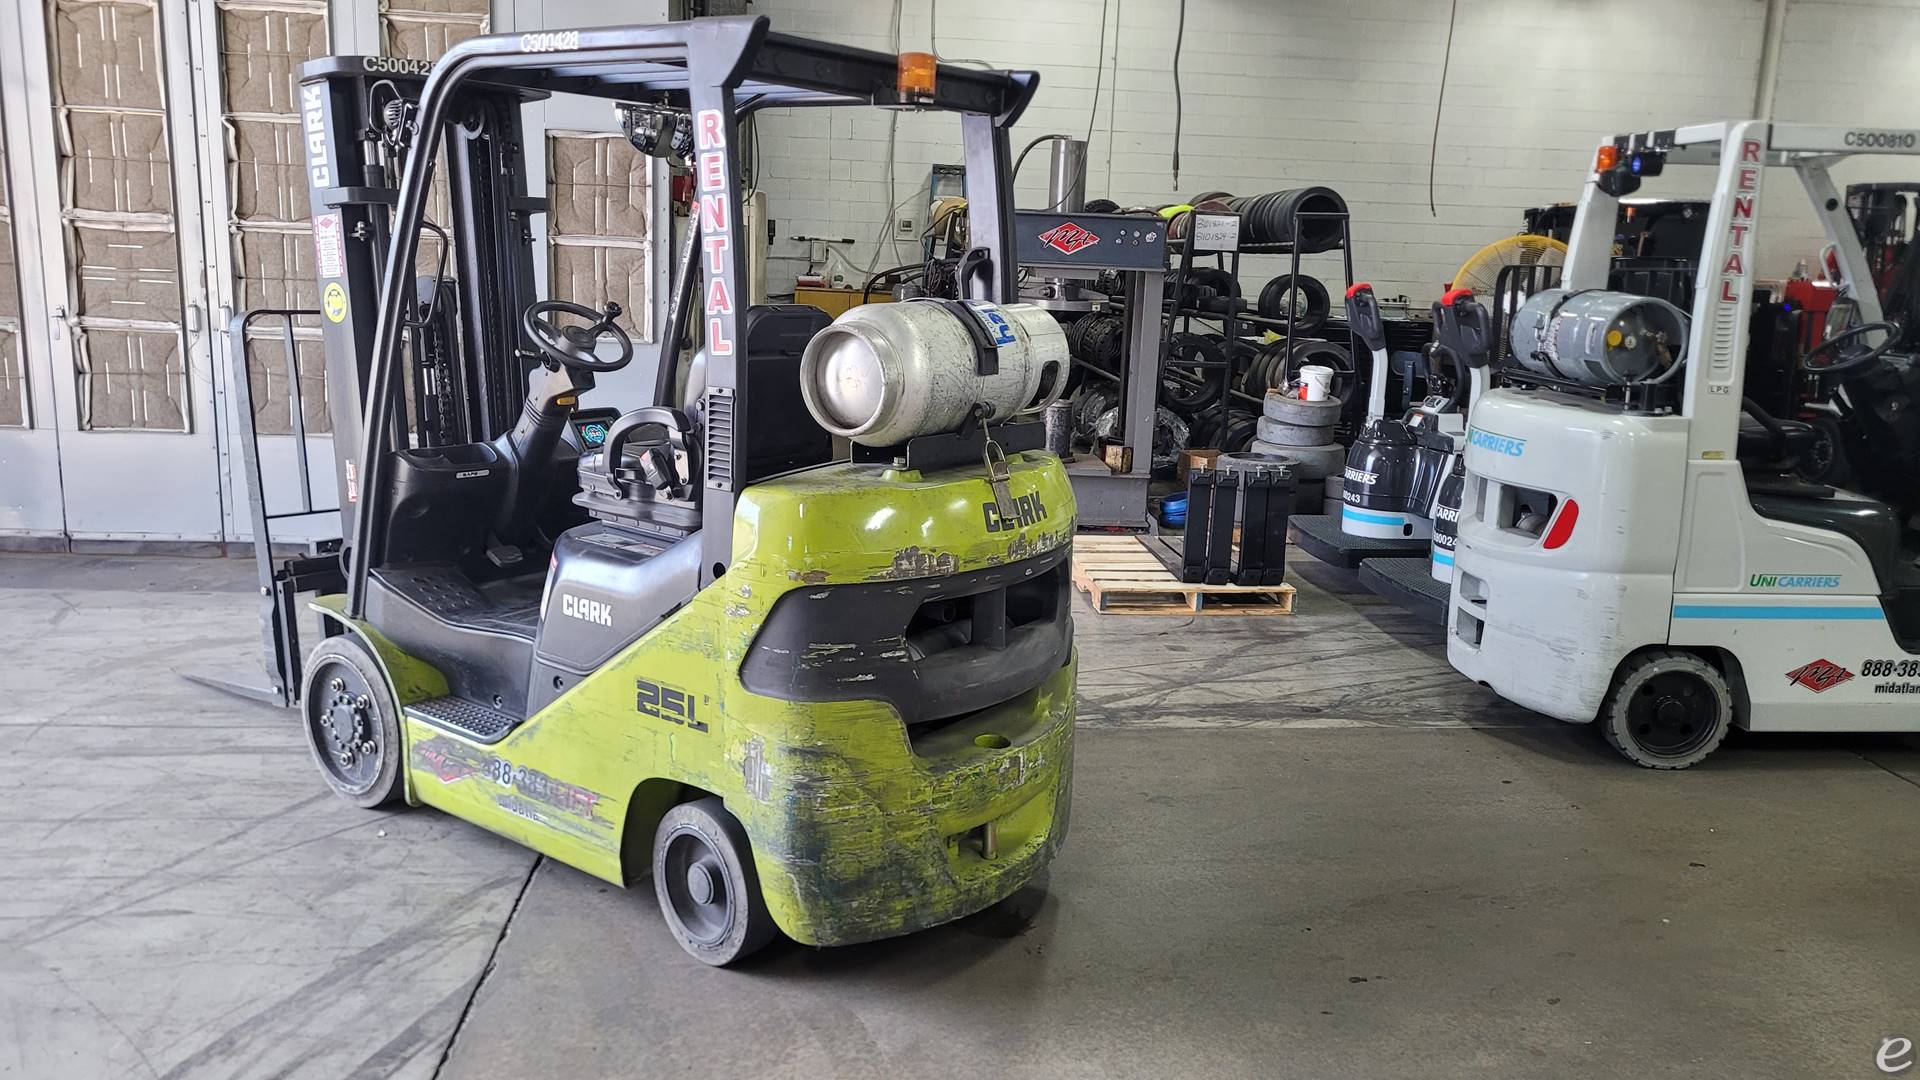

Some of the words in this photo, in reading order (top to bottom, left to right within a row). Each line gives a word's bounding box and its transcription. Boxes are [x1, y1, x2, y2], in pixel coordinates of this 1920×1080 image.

[520, 31, 579, 52] C500428
[303, 85, 330, 188] CLARK
[699, 110, 733, 355] RENTAL
[1720, 140, 1761, 303] RENTAL
[1710, 385, 1729, 393] LPG
[562, 594, 612, 627] CLARK
[636, 679, 709, 733] 25L
